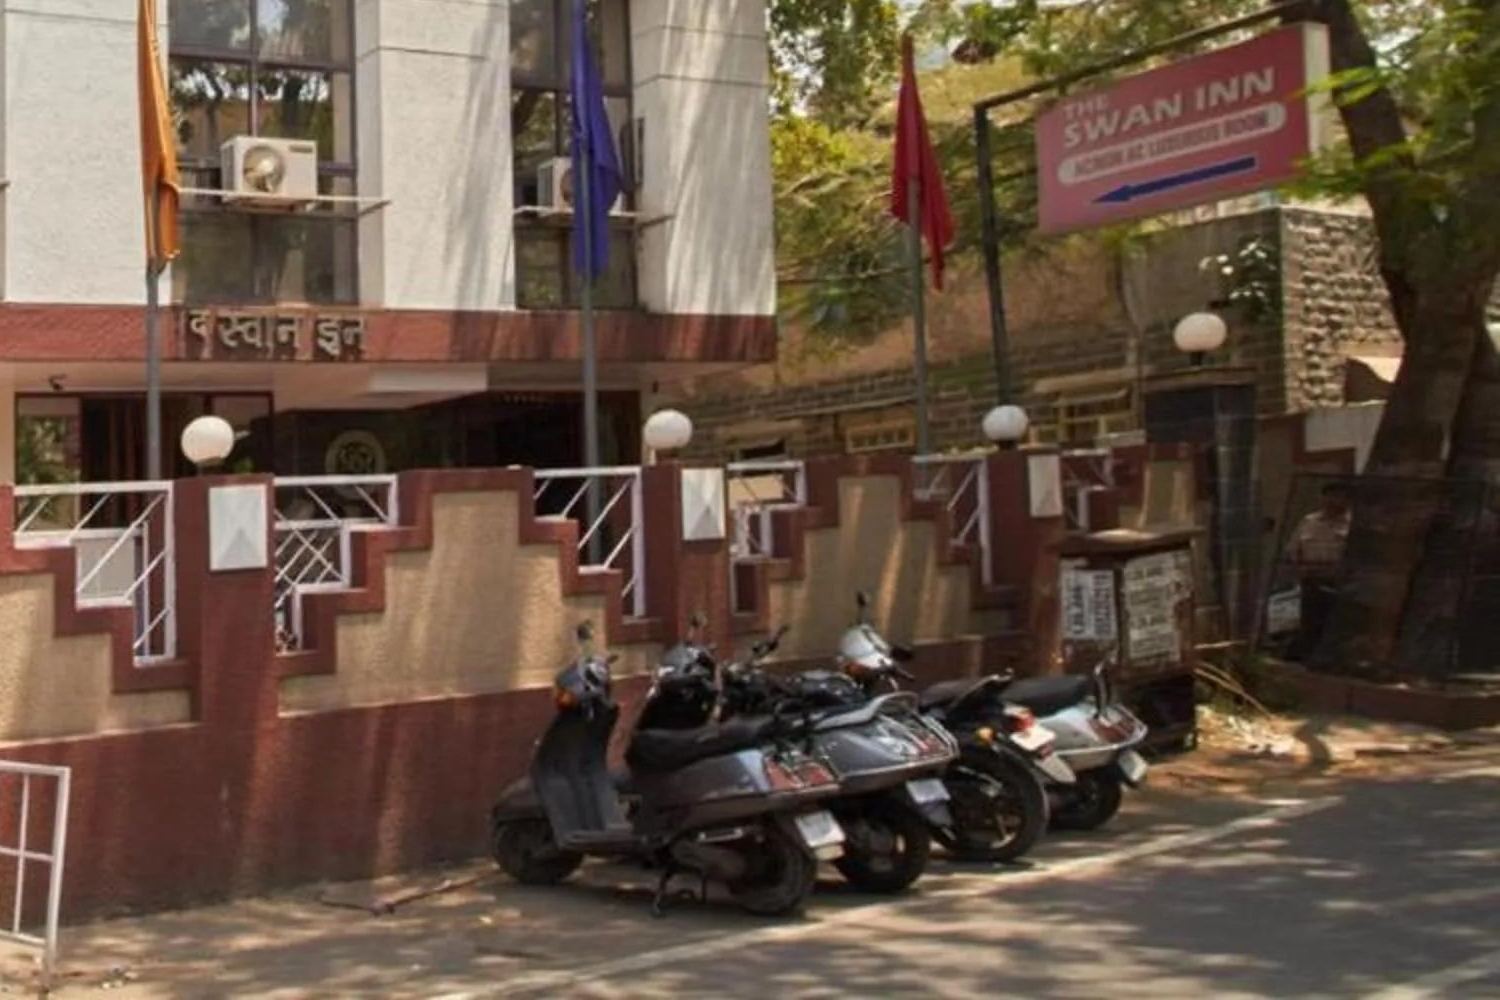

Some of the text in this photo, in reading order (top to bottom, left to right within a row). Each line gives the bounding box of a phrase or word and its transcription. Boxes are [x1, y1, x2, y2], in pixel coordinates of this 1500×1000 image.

[1063, 93, 1182, 148] SWAN
[1196, 66, 1276, 111] INN
[1064, 93, 1109, 121] THE
[316, 312, 365, 357] इन
